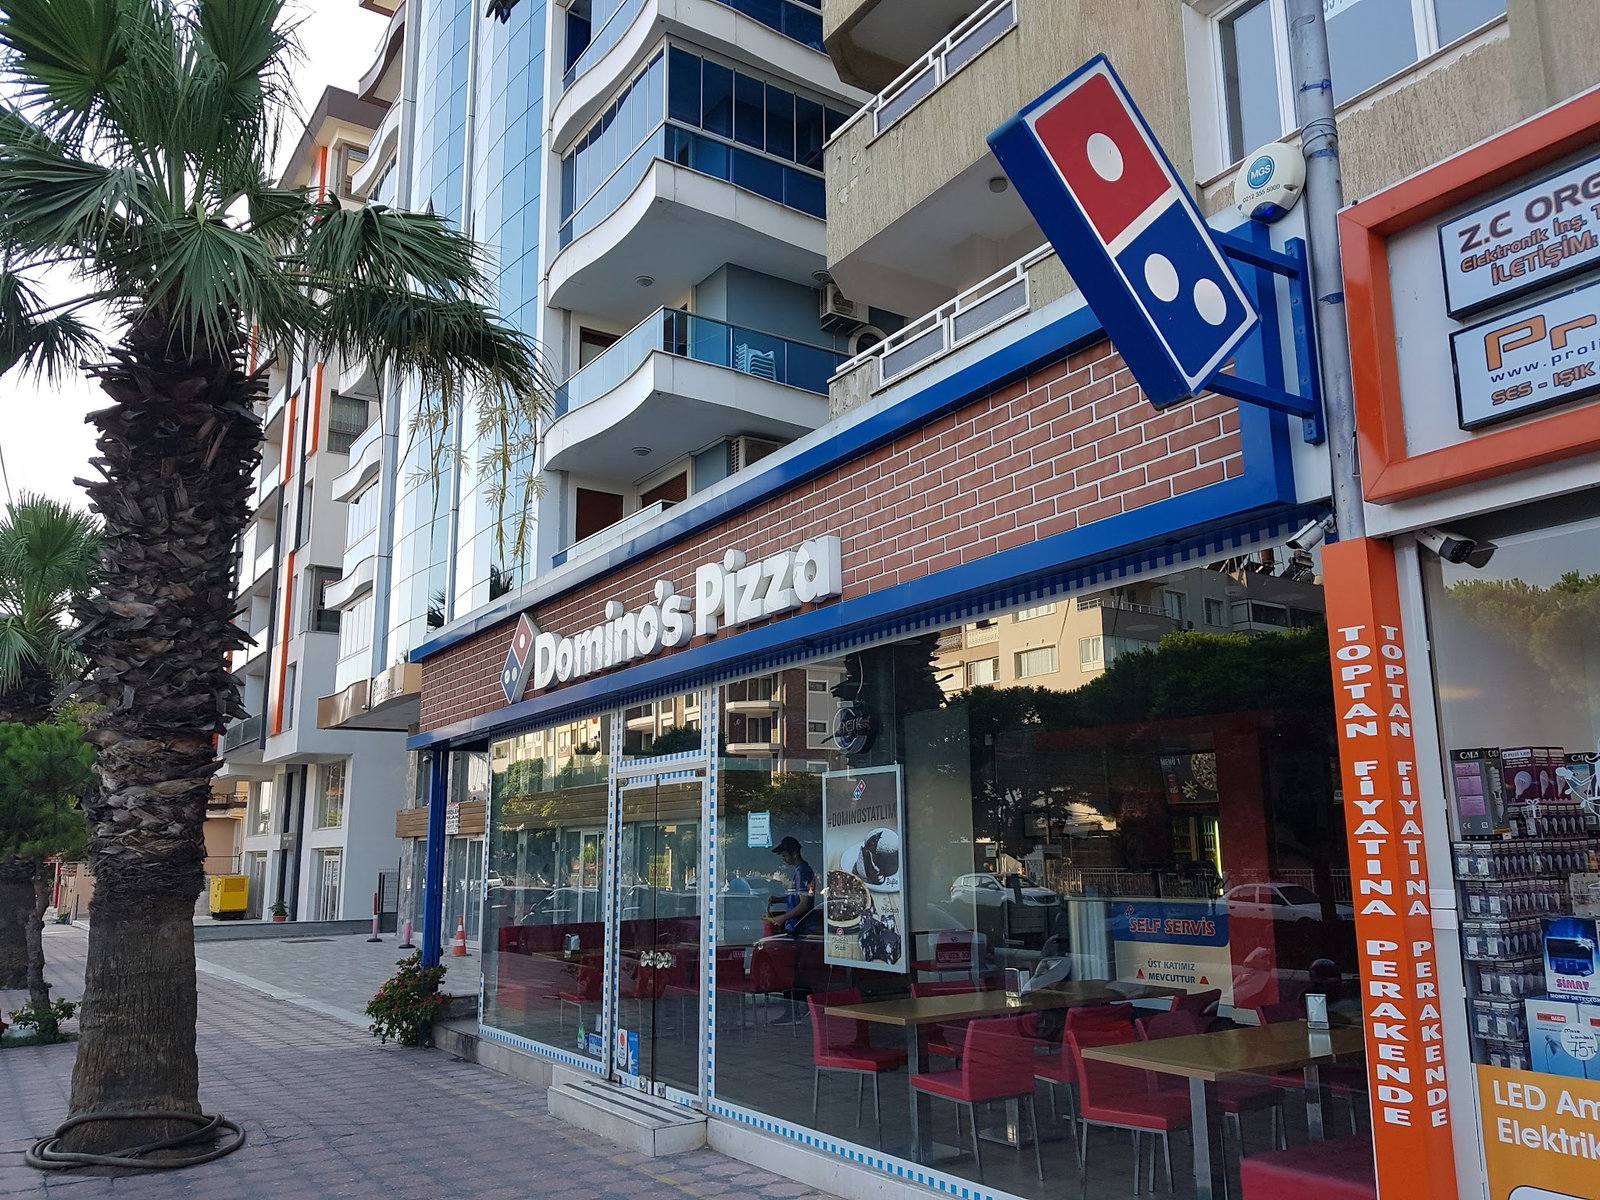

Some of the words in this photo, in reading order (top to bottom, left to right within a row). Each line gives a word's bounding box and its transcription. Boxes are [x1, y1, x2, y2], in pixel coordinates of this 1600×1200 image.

[1250, 164, 1271, 180] MGS
[1458, 210, 1513, 254] Z.C
[1460, 227, 1549, 273] Elektronik
[1491, 381, 1533, 406] SES
[1552, 361, 1597, 388] IŞIK
[534, 580, 694, 690] Domino's
[695, 535, 842, 637] Pizza
[1336, 624, 1378, 738] TOPTAN
[1366, 939, 1414, 1127] PERAKENDE
[1380, 624, 1410, 737] TOPTAN
[1412, 940, 1448, 1128] PERAKENDE
[1129, 917, 1161, 934] SELF
[1164, 917, 1216, 936] SERVİS
[1147, 958, 1161, 968] ÜST
[1163, 961, 1196, 971] KATIMIZ
[1148, 972, 1196, 984] MEVCUTTUR
[1493, 1080, 1547, 1111] LED
